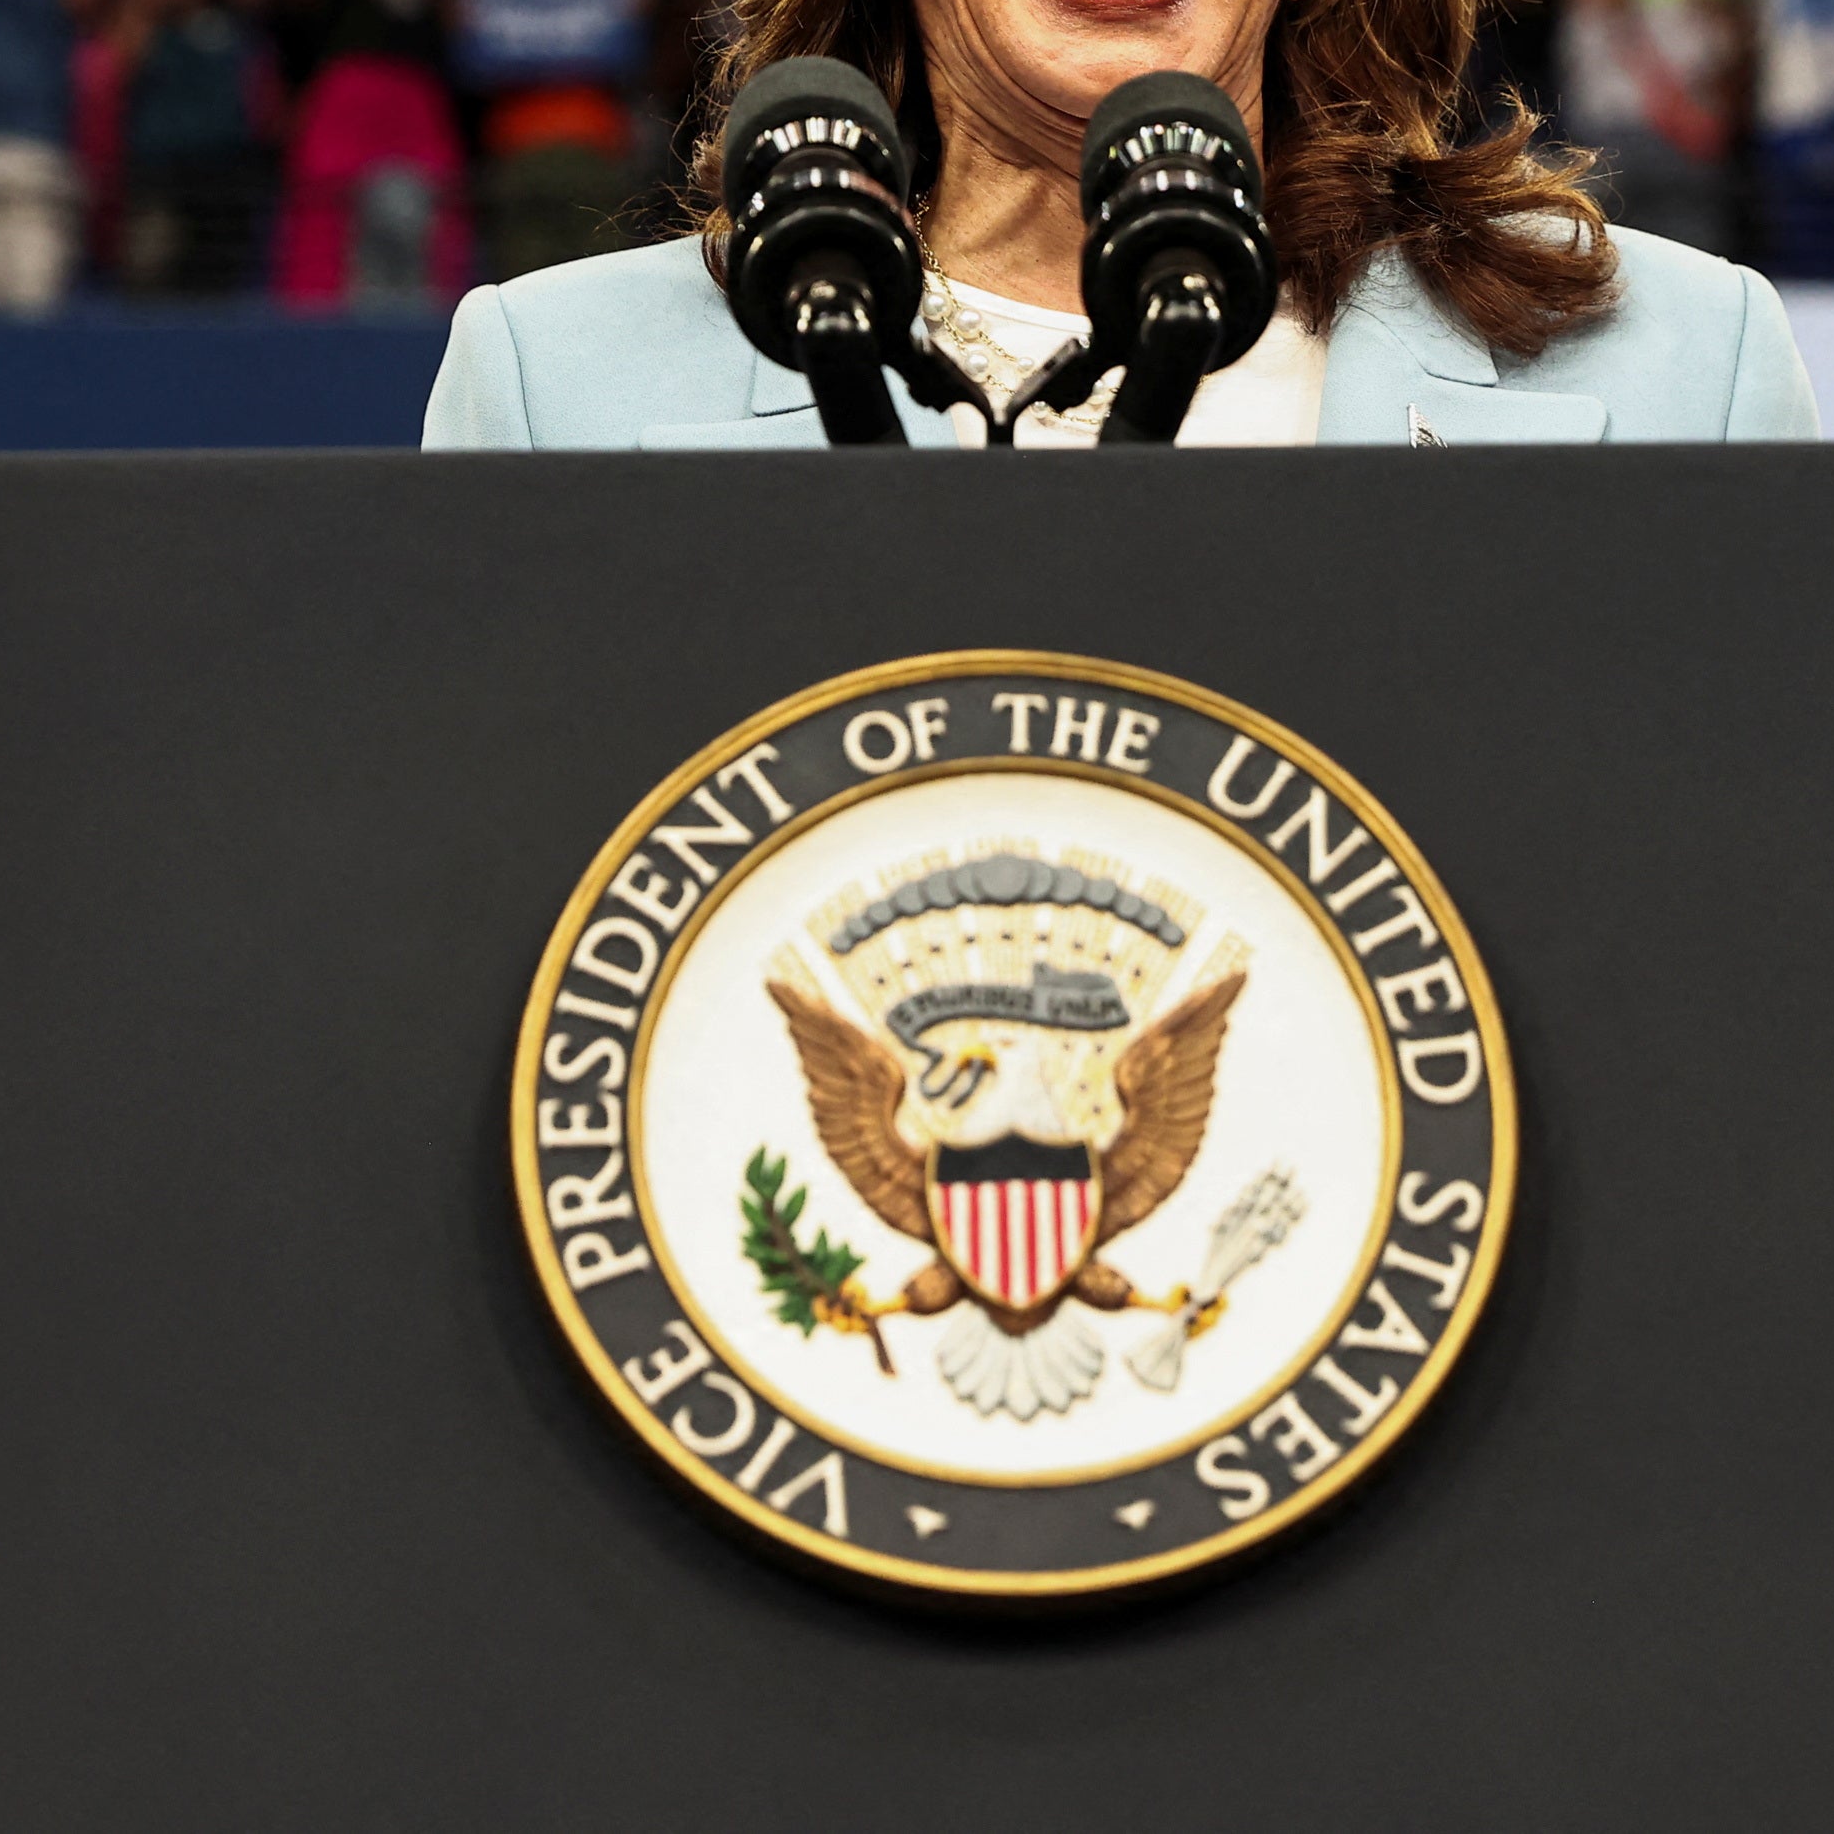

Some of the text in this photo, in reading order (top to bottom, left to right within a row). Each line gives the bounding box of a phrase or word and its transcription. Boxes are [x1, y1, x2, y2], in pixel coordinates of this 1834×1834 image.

[539, 693, 1482, 1536] VICE PRESIDENT OF THE UNITED STATES
